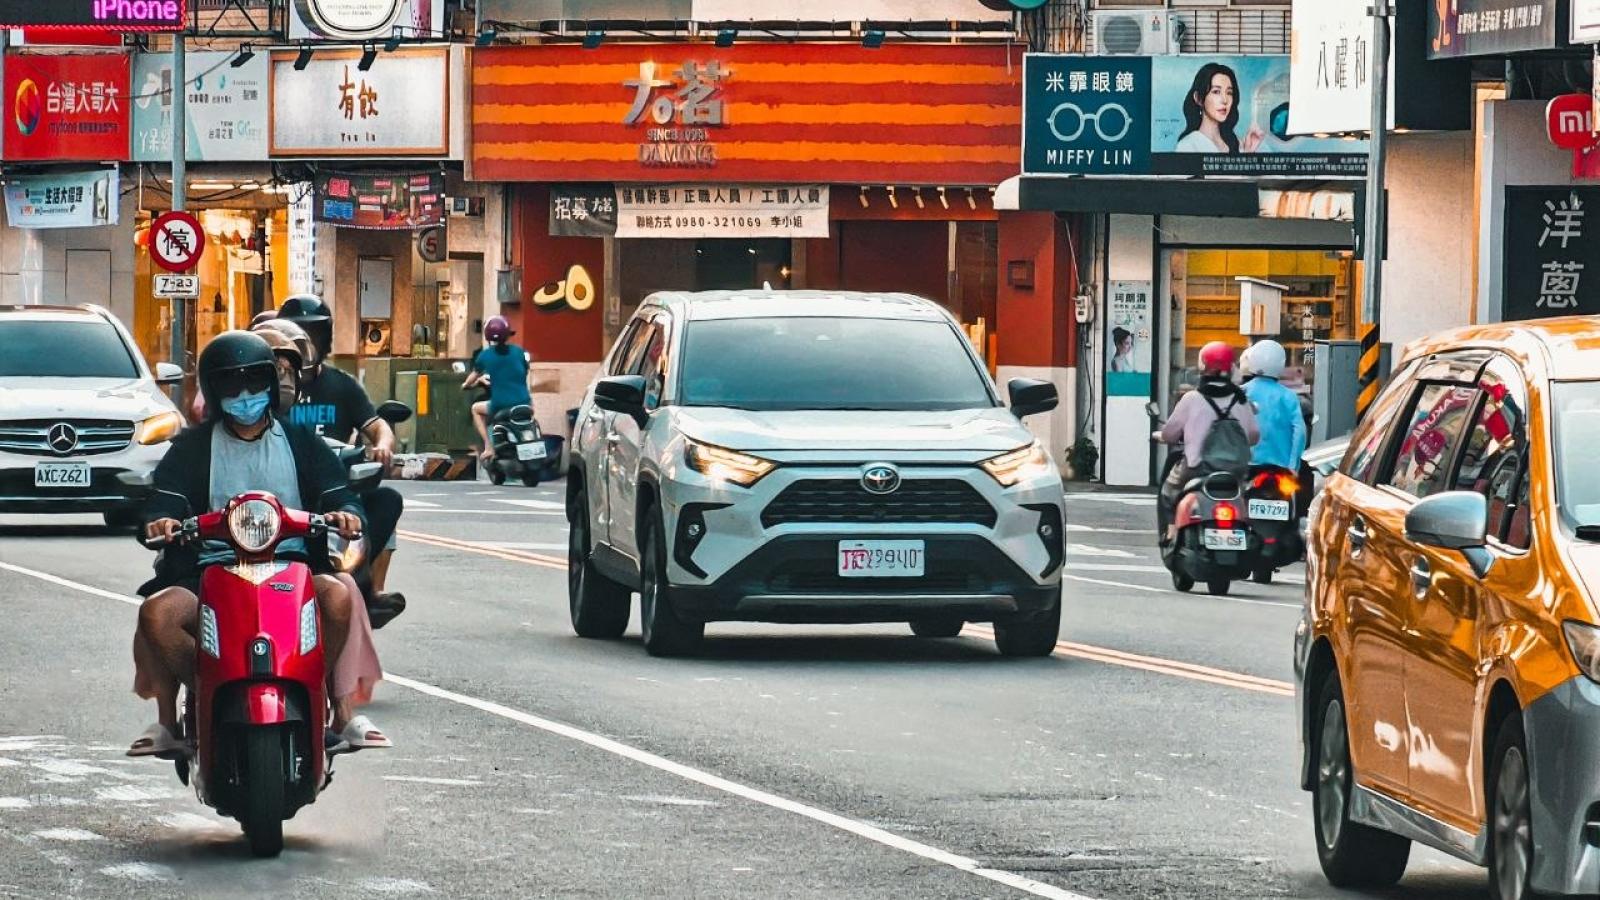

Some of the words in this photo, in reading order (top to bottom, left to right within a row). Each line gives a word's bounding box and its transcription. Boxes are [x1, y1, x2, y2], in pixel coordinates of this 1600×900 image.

[93, 0, 178, 20] iPhone
[46, 81, 119, 114] 台灣大哥大
[1047, 150, 1094, 165] MIFFY
[1103, 149, 1132, 165] LIN
[554, 197, 589, 220] 招募
[675, 216, 761, 228] 0980-321069
